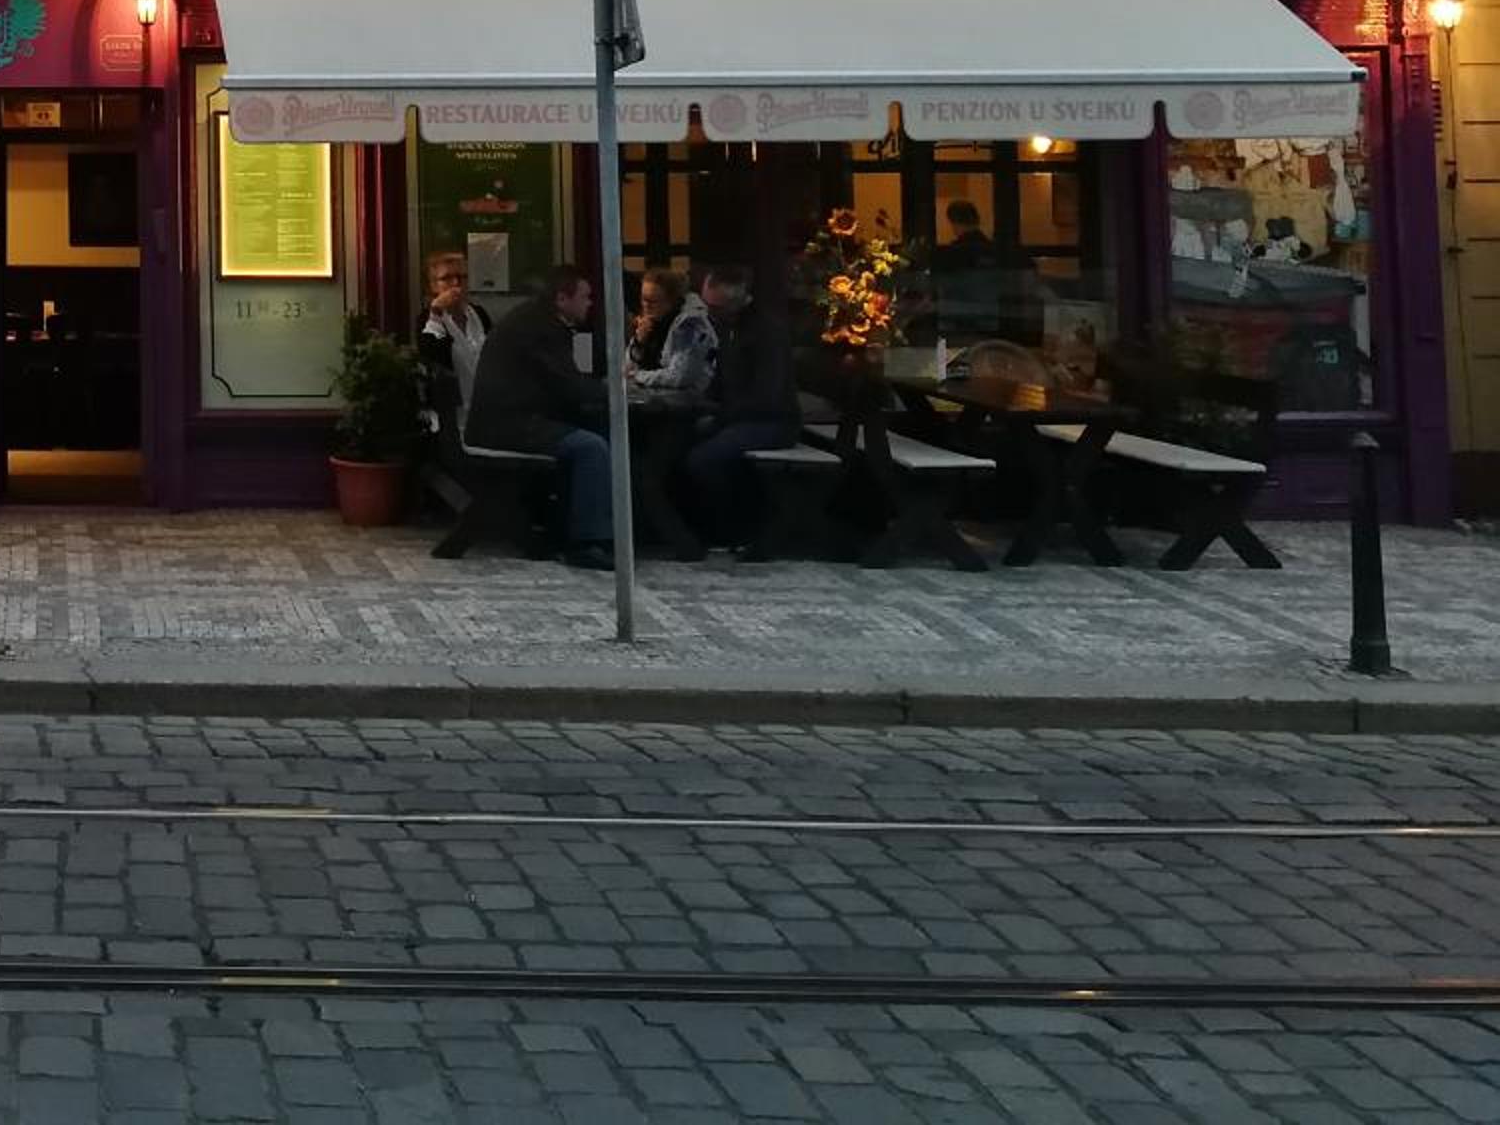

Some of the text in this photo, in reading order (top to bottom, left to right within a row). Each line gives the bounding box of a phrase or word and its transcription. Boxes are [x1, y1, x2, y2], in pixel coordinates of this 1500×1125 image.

[426, 98, 682, 124] RESTAURACE U VEJKŮ
[921, 96, 1135, 121] PENZION U ŠVEJKŮ
